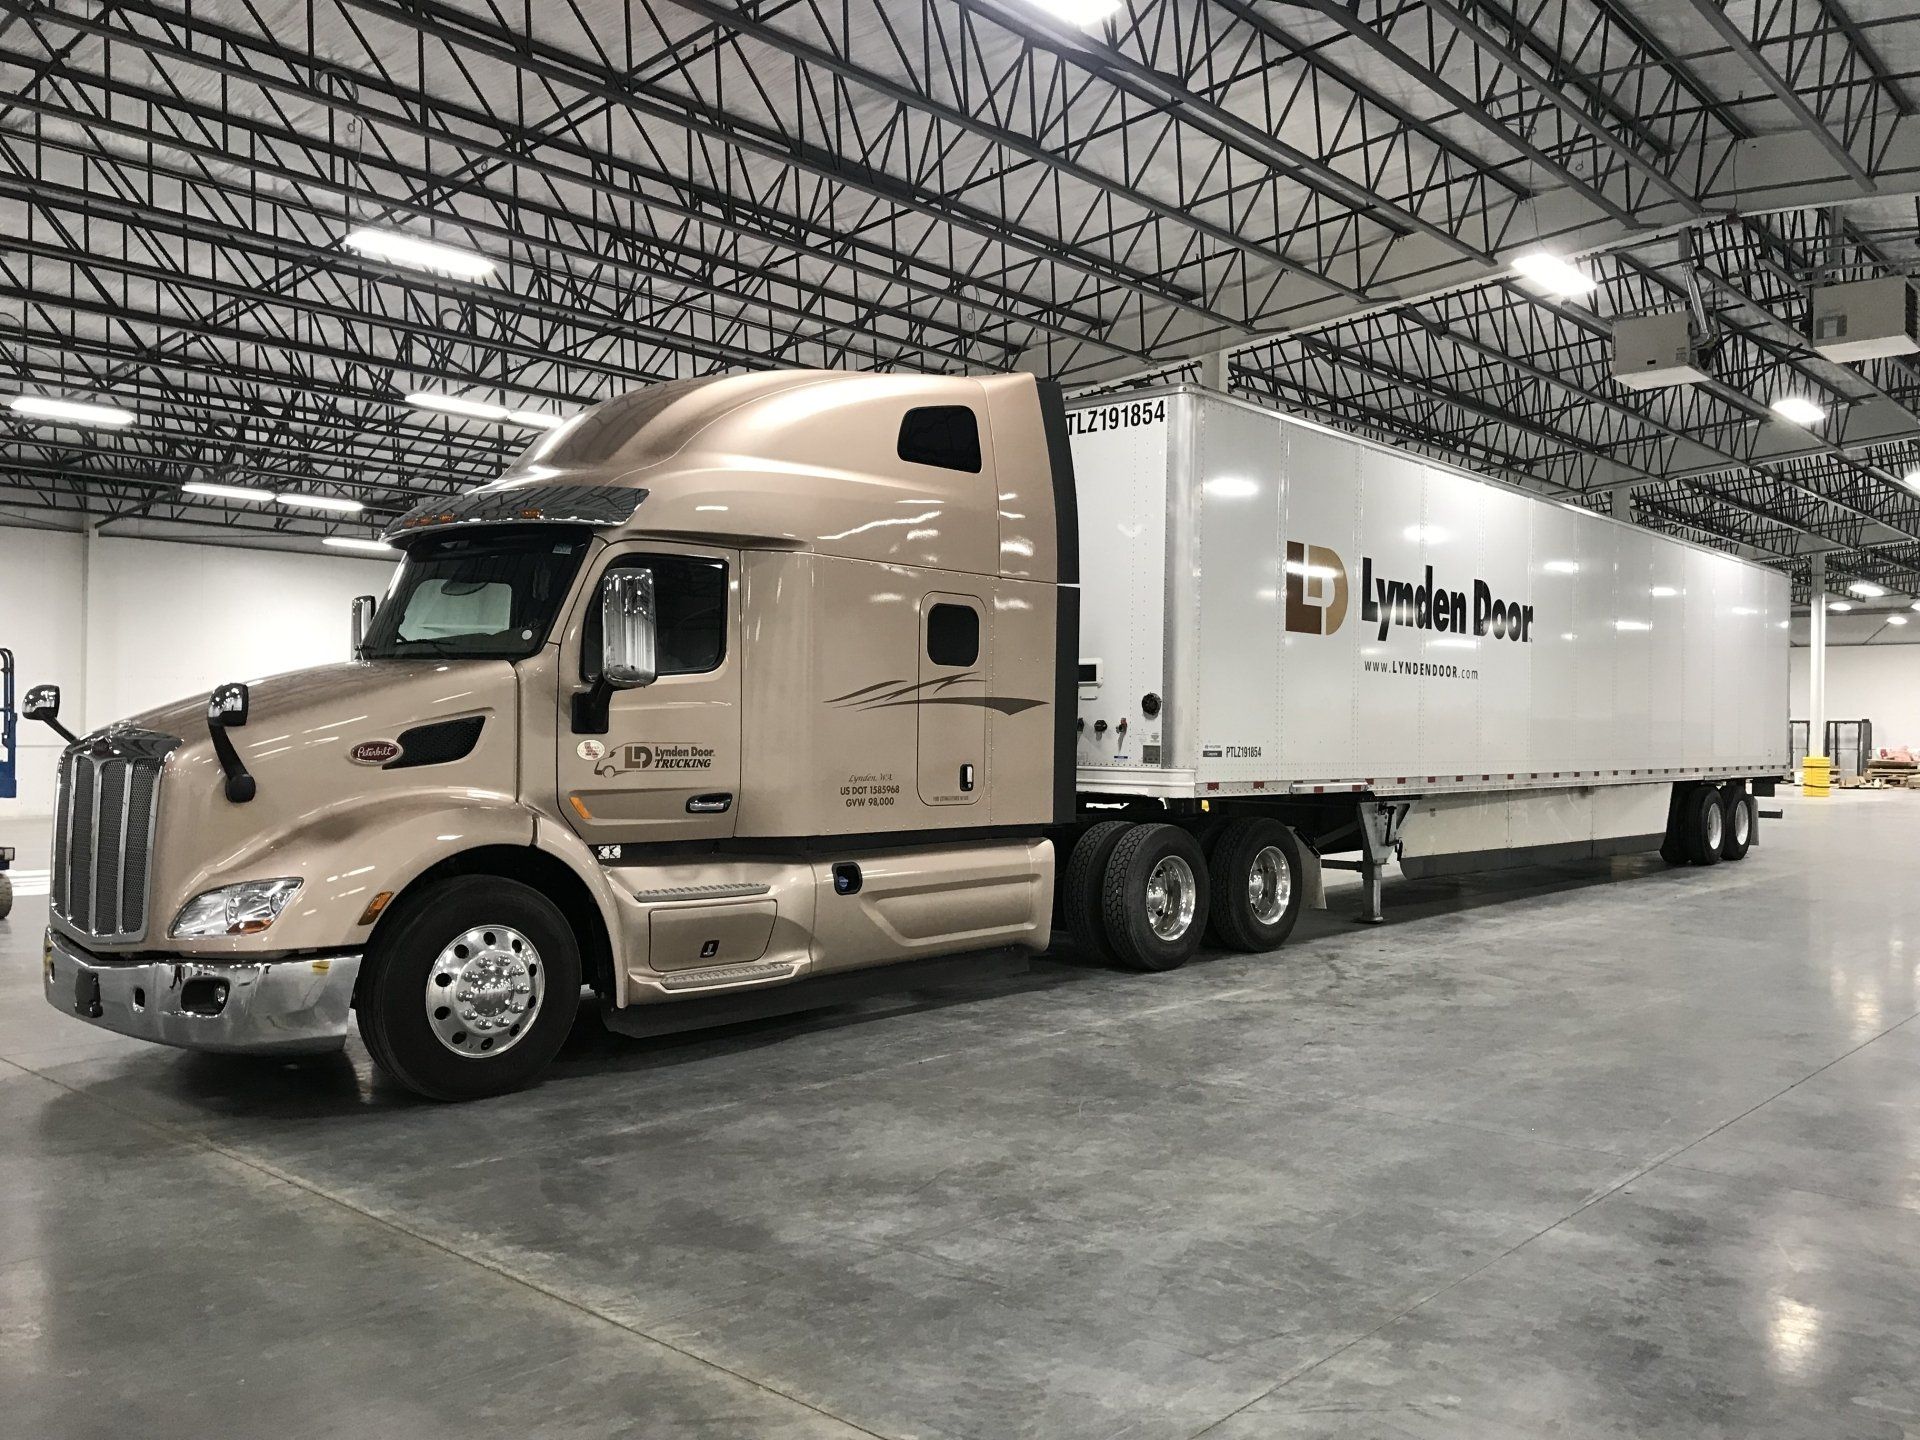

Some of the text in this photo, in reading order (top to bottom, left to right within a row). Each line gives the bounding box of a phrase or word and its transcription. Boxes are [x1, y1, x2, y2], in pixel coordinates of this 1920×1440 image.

[1065, 400, 1165, 435] TLZ191854
[1361, 556, 1467, 642] Lynden
[1473, 578, 1534, 643] Door
[1364, 660, 1479, 680] www.LYNDENDOOR.com
[357, 746, 394, 758] Peterbilt
[655, 745, 689, 761] Lynden
[691, 746, 714, 757] Door
[1226, 746, 1261, 758] PTLZ191854
[654, 758, 711, 769] TRUCKING
[840, 784, 900, 796] US DOT 1585968
[845, 796, 895, 807] GVW 98,000
